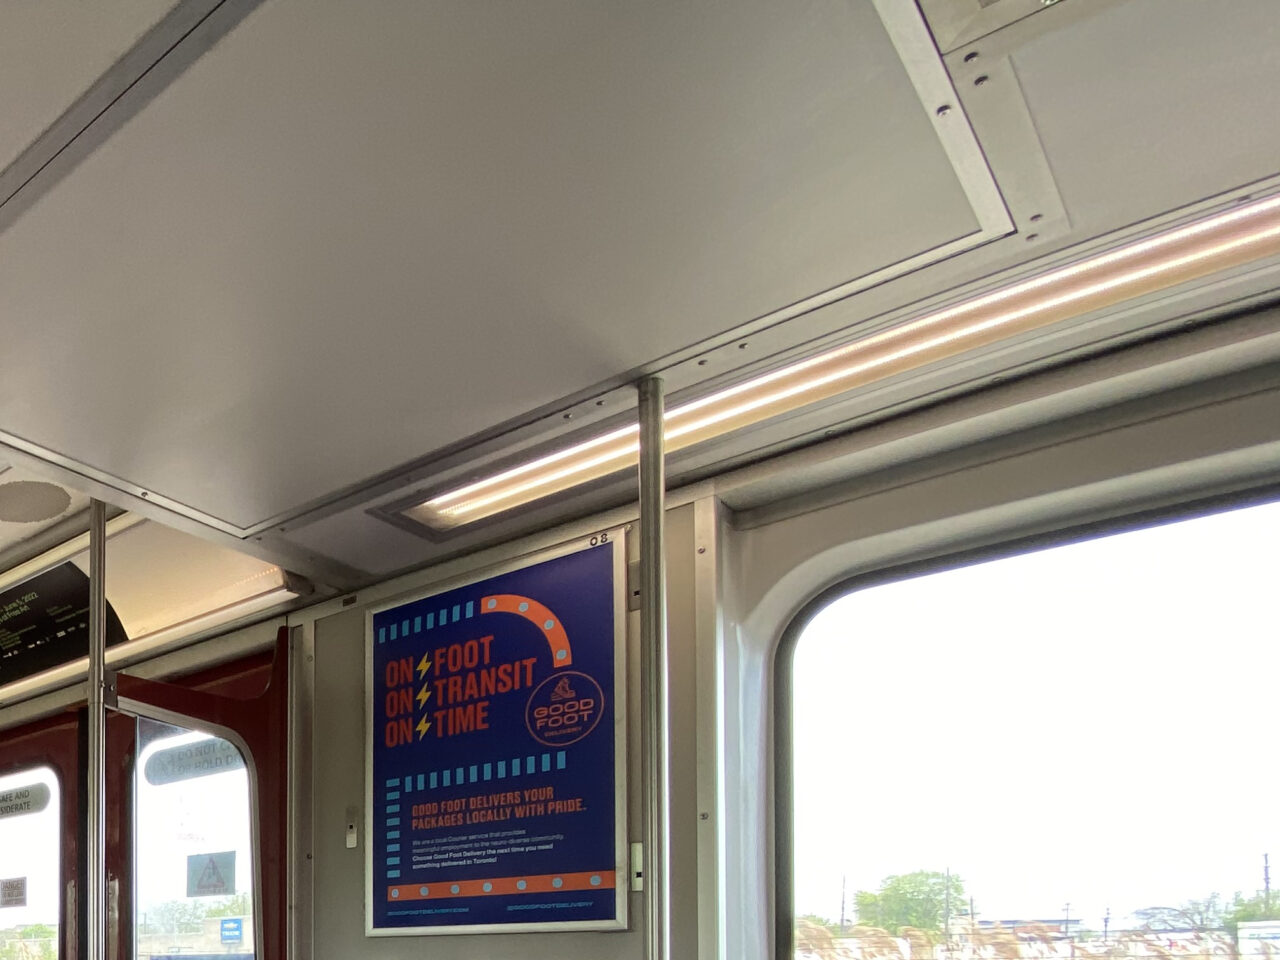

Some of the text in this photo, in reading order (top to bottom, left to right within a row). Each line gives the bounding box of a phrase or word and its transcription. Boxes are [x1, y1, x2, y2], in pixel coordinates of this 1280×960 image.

[386, 634, 494, 688] ON FOOT
[386, 658, 537, 718] ON TRANSIT
[534, 698, 594, 718] GOOD
[536, 710, 593, 730] FOOT
[385, 701, 490, 748] ON TIME
[14, 790, 30, 800] AND
[412, 786, 554, 816] GOOD FOOT DELIVERS YOUR
[412, 798, 588, 830] PACKAGES LOCALLY WITH PRIDE.
